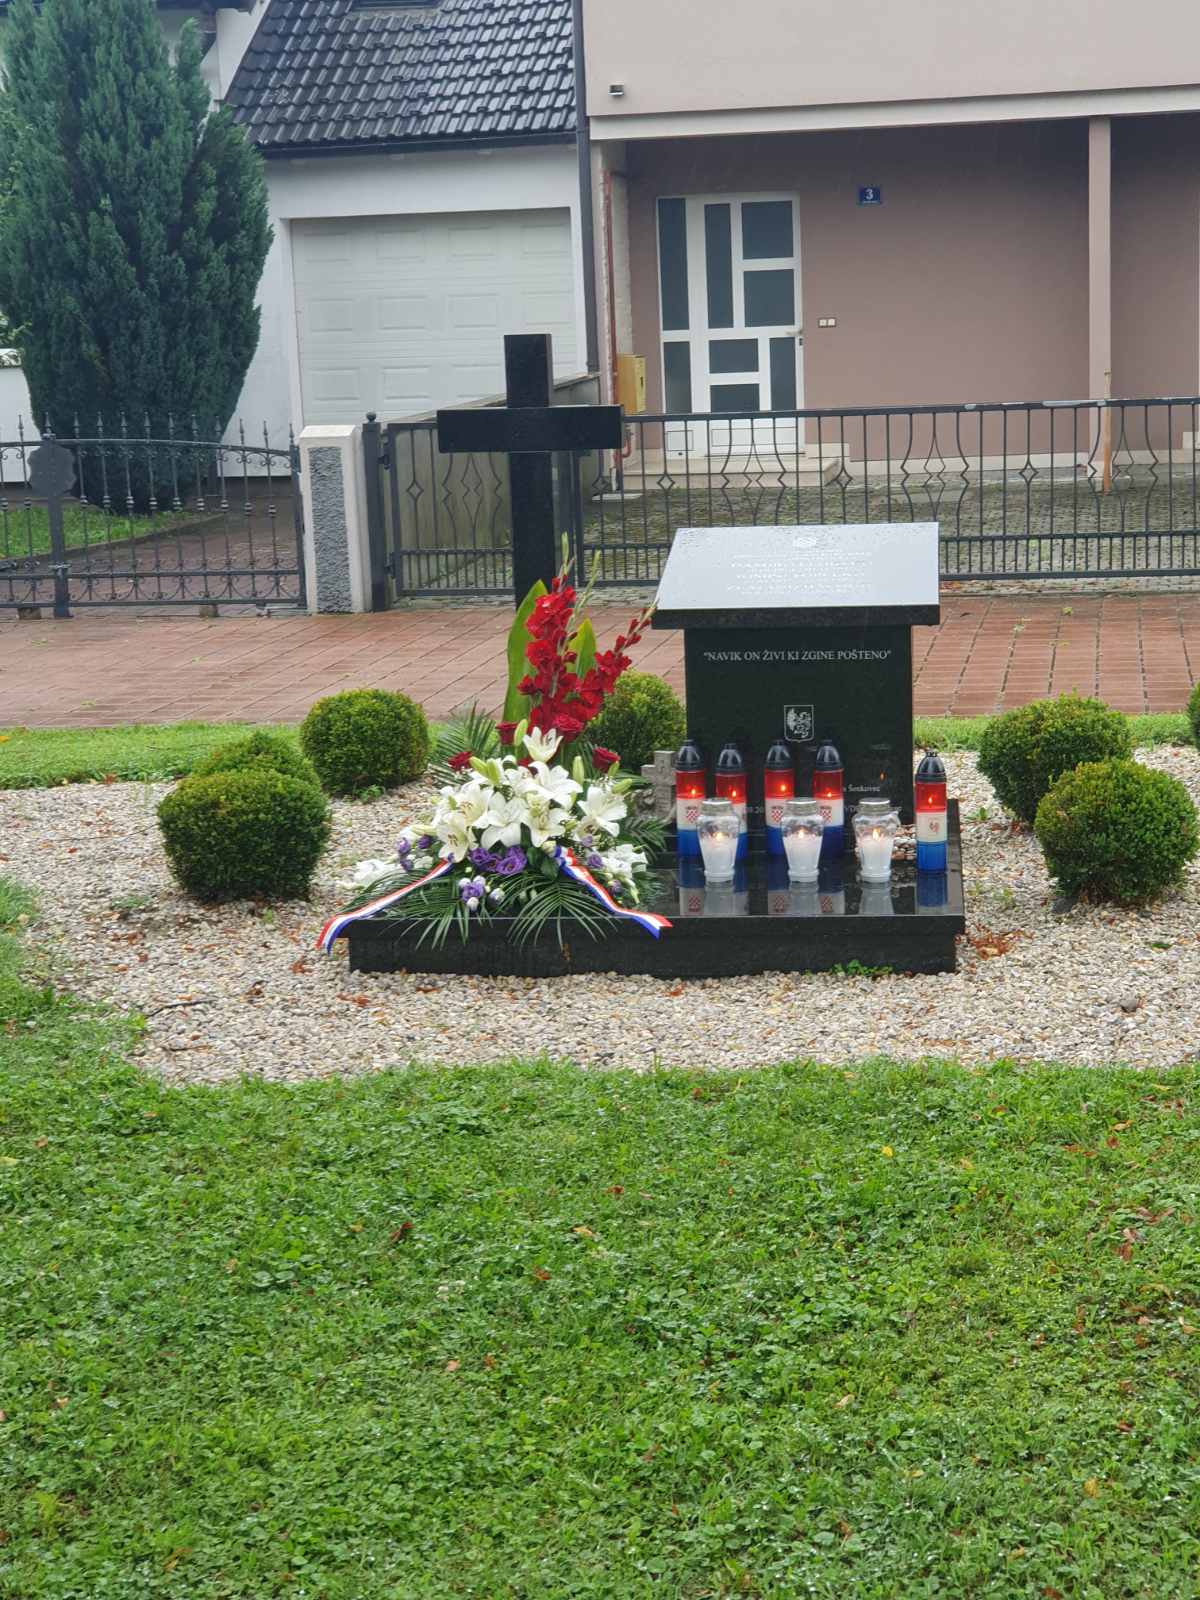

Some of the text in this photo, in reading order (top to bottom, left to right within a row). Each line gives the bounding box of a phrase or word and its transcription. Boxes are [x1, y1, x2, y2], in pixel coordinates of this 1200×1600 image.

[865, 188, 874, 200] 3
[703, 648, 892, 662] "NAVIK ON ŽIVI KI ZGINE POŠTENO"
